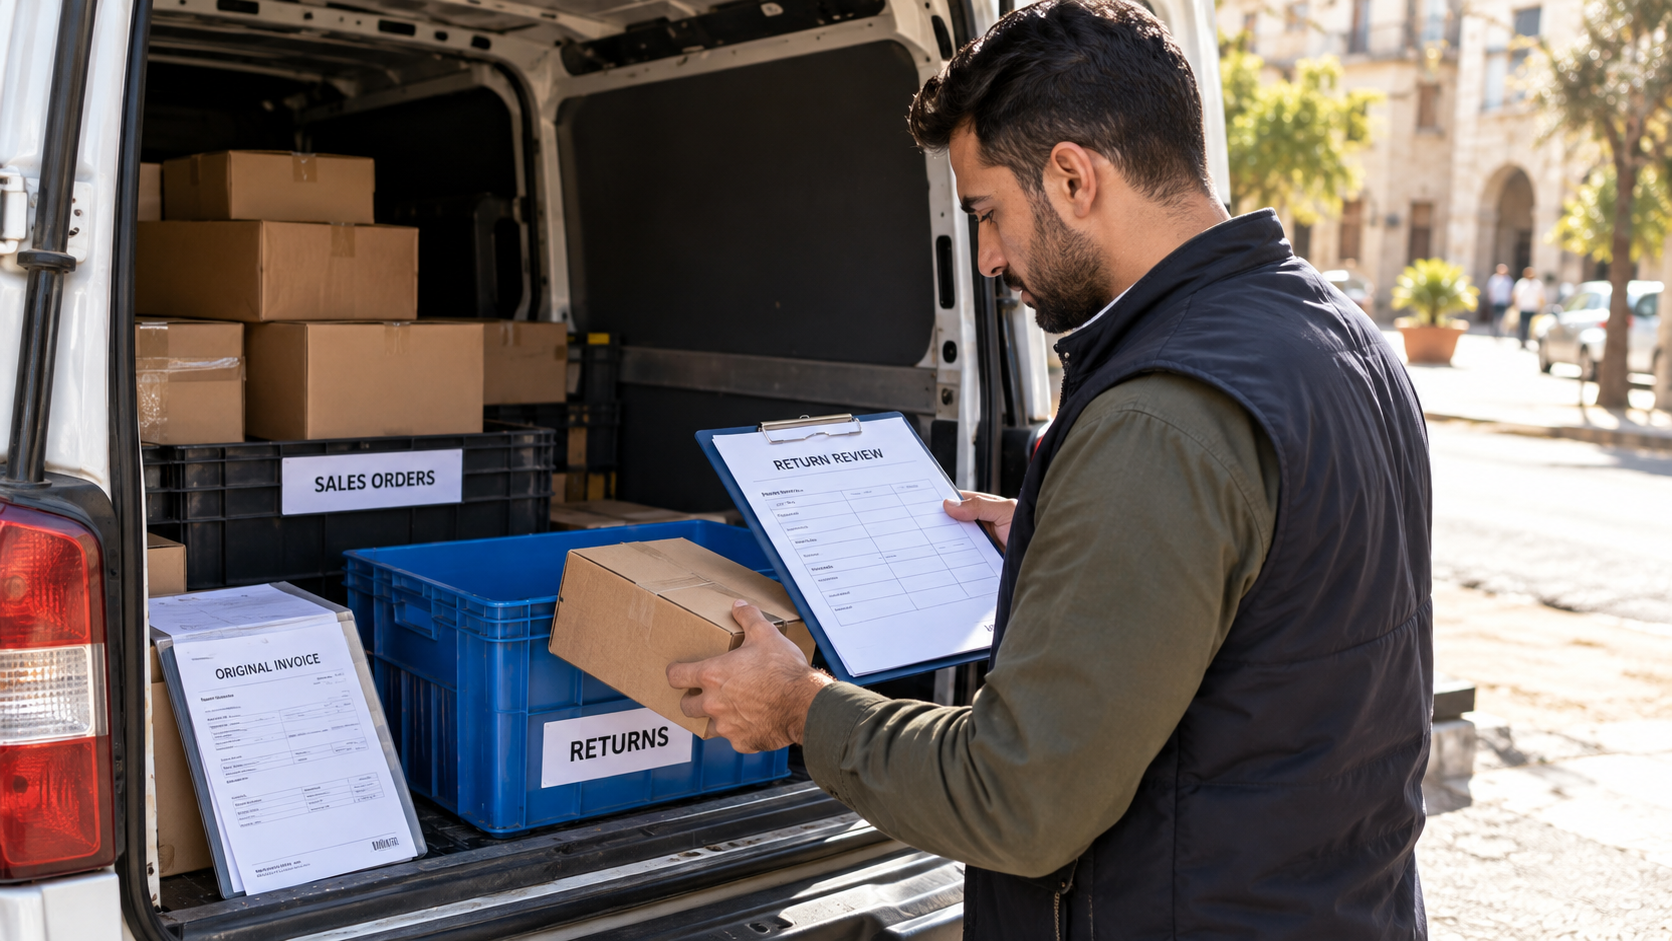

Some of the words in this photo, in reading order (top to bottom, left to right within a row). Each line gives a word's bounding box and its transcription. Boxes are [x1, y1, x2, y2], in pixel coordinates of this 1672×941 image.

[773, 454, 831, 470] RETURN
[832, 448, 884, 464] REVIEW
[315, 474, 366, 493] SALES
[371, 470, 435, 489] ORDERS
[215, 661, 272, 680] ORIGINAL
[274, 653, 321, 671] INVOICE
[570, 726, 669, 762] RETURNS
